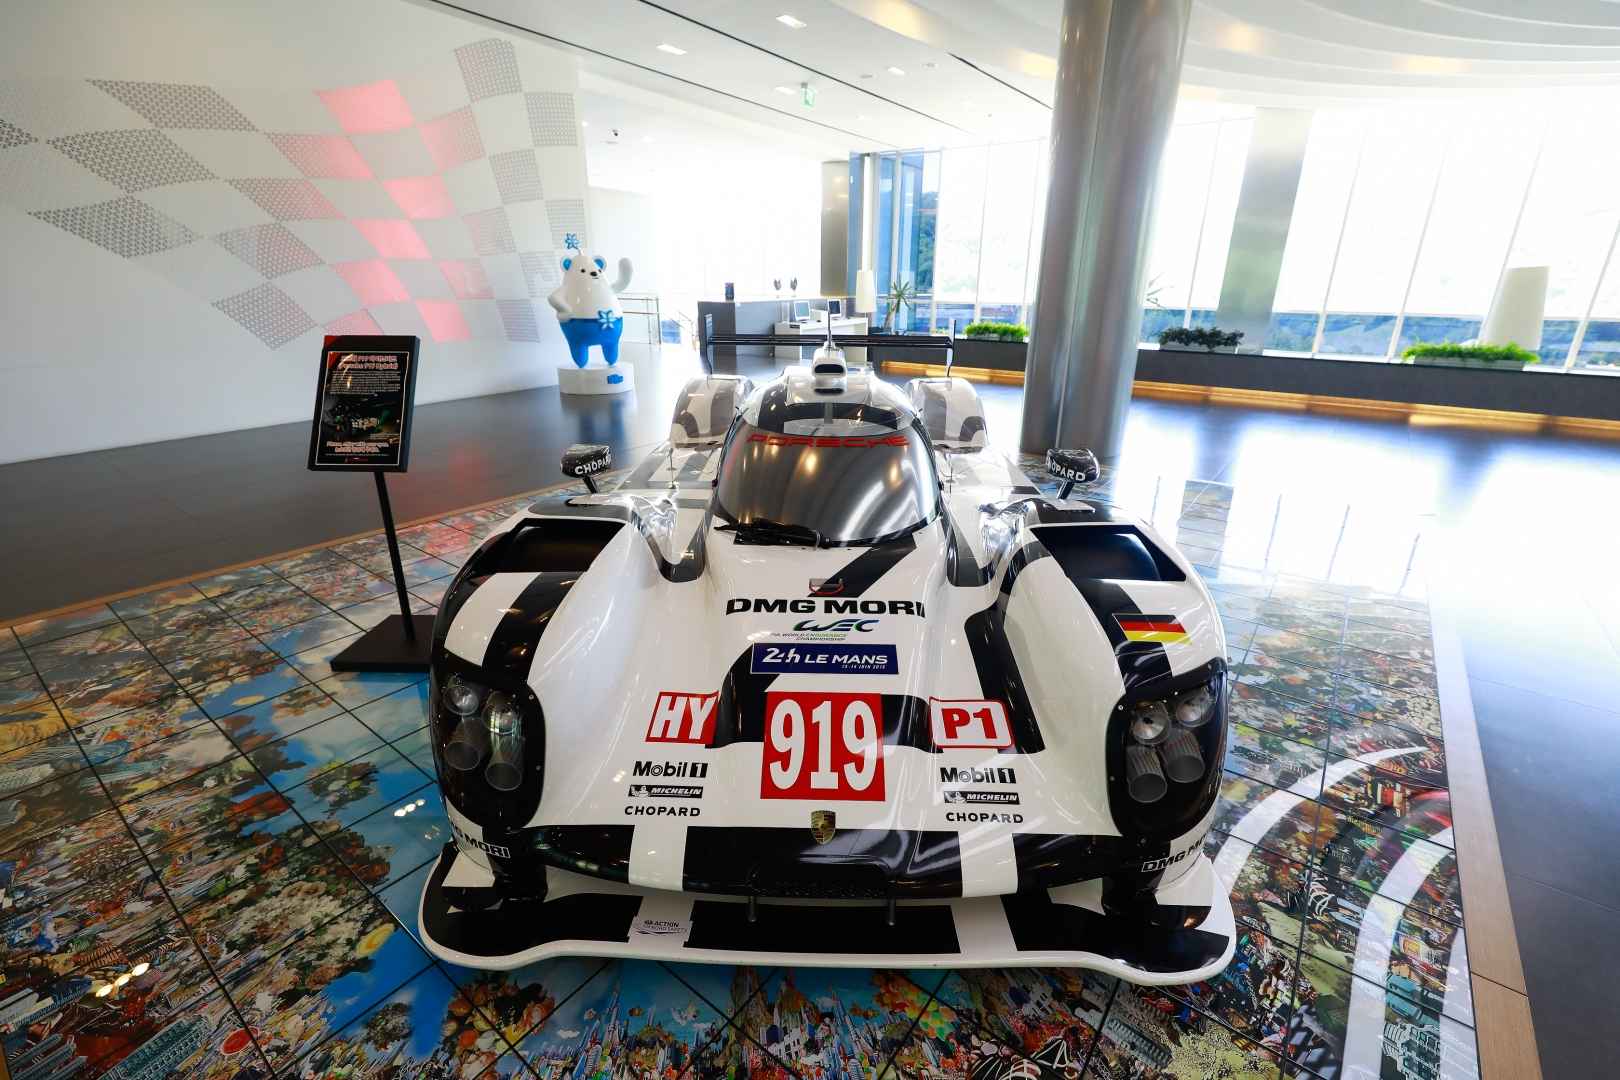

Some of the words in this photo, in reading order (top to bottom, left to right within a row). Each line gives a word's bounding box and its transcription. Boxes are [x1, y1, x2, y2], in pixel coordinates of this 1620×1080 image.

[726, 598, 816, 616] DMG
[823, 600, 926, 618] MORI
[793, 618, 880, 633] WEC
[804, 654, 829, 664] LE
[831, 654, 888, 664] MANS
[649, 695, 717, 740] HY
[941, 708, 997, 739] P1
[769, 700, 878, 791] 919
[632, 761, 688, 778] Mobil
[692, 763, 706, 778] 1
[940, 767, 997, 784] Mobil
[999, 768, 1014, 783] 1
[651, 787, 702, 795] MICHELIN
[624, 806, 701, 817] CHOPARD
[945, 812, 1024, 824] CHOPARD
